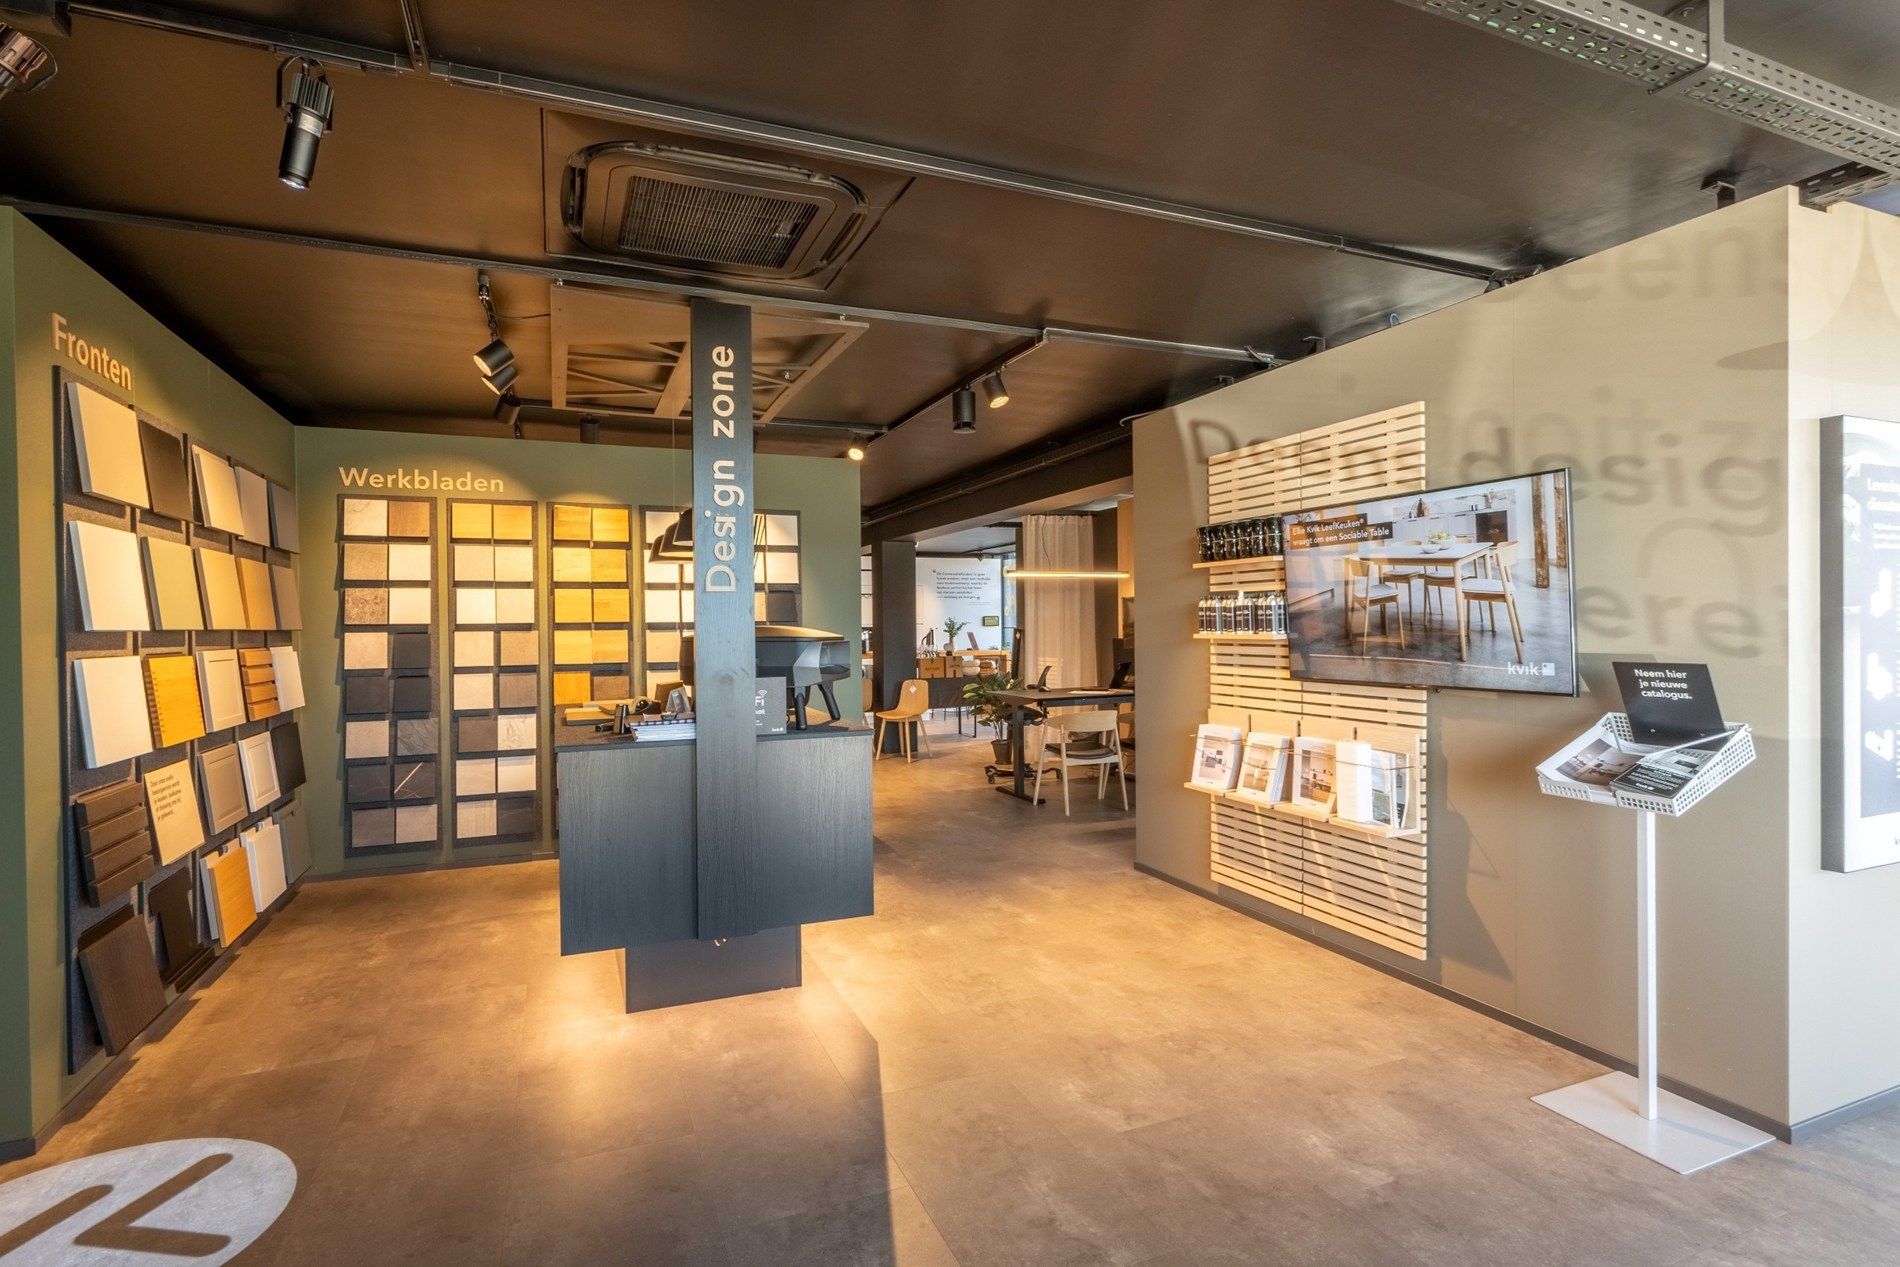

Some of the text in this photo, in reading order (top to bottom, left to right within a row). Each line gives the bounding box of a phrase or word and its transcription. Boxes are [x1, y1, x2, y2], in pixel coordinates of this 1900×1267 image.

[52, 312, 132, 391] Fronten
[705, 345, 745, 592] Design zone
[338, 466, 504, 493] Werkbladen
[1293, 538, 1313, 547] vraagt
[1338, 530, 1368, 541] Sociable
[1369, 527, 1390, 537] Table
[1507, 661, 1540, 676] kvik
[1633, 669, 1687, 679] Neem hier
[1638, 679, 1688, 689] je nieuwe
[1641, 689, 1693, 700] catalogus.
